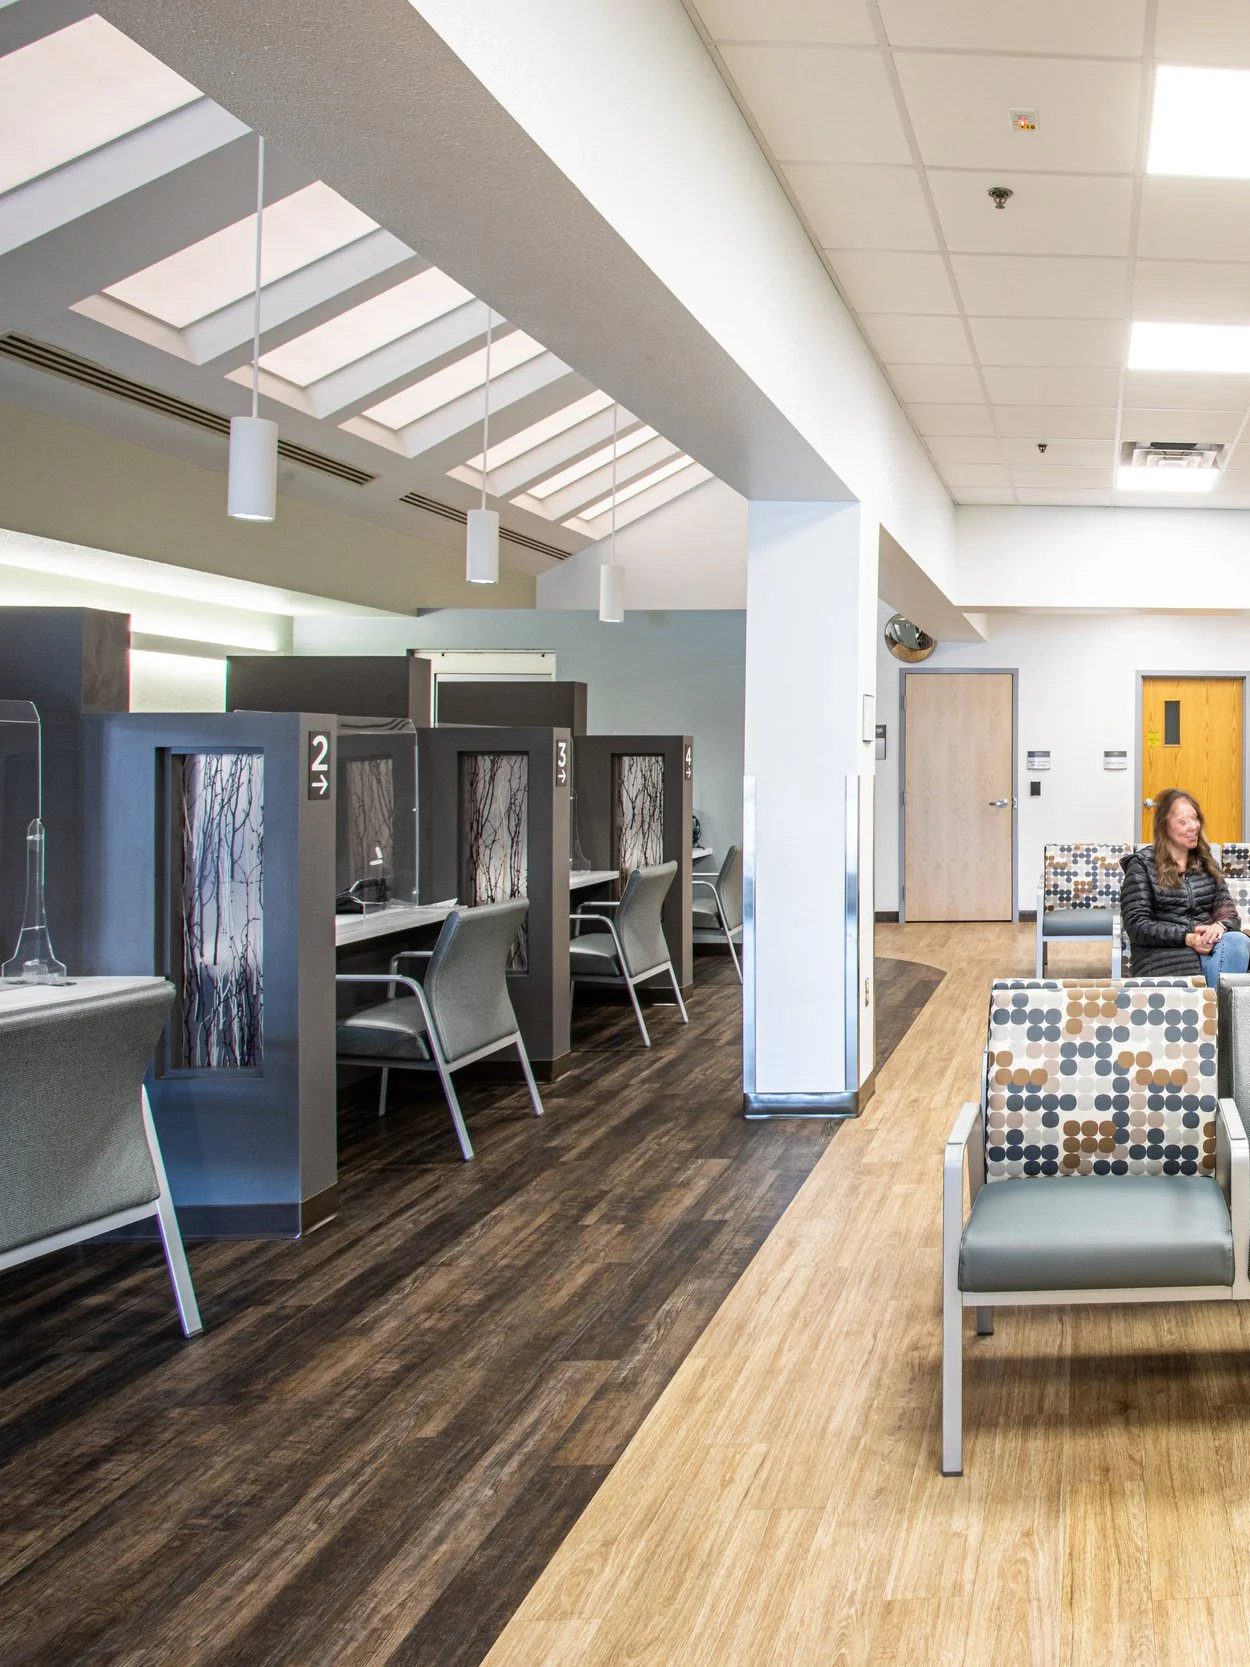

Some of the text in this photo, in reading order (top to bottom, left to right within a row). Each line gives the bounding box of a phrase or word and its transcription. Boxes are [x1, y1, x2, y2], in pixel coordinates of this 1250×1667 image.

[311, 735, 329, 772] 2
[557, 742, 567, 768] 3
[685, 746, 692, 766] 4
